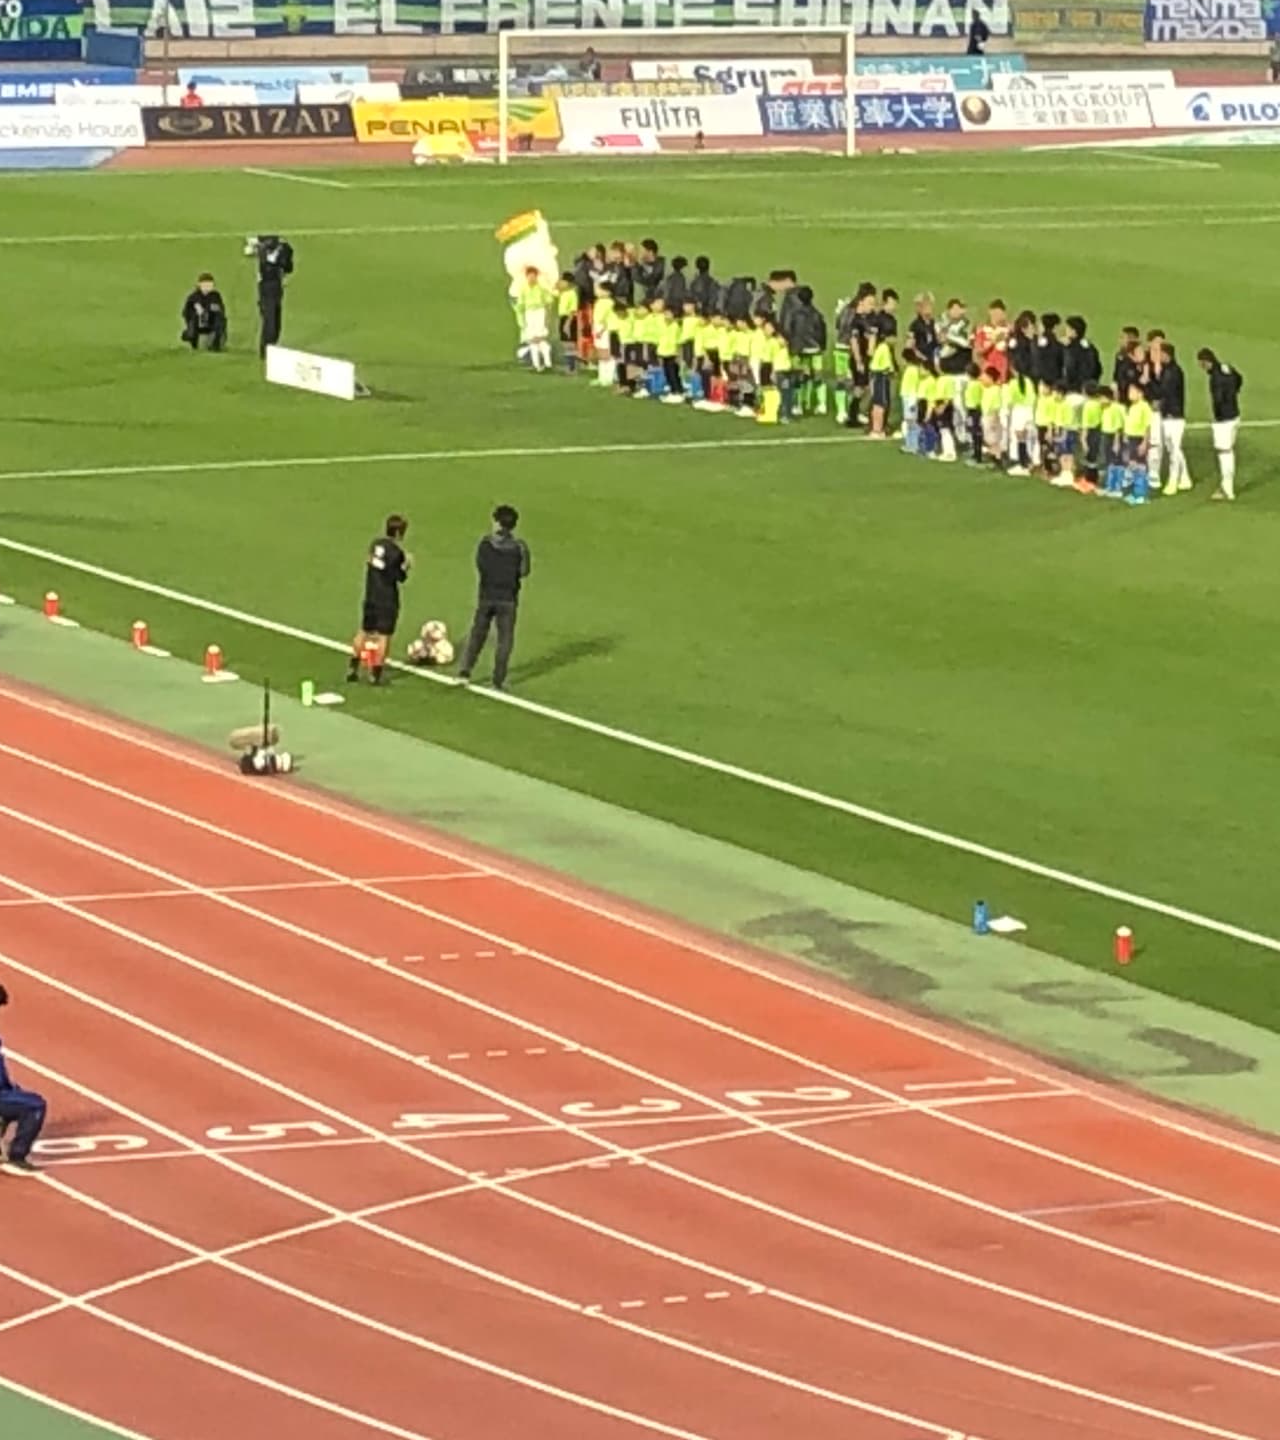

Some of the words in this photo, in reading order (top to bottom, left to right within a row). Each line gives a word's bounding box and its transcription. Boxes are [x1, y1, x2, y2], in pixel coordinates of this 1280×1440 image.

[1073, 89, 1147, 108] GROUP
[223, 108, 341, 135] RIZAP
[766, 95, 955, 130] 産業能率大学
[78, 121, 138, 138] House
[366, 116, 512, 137] PENALT
